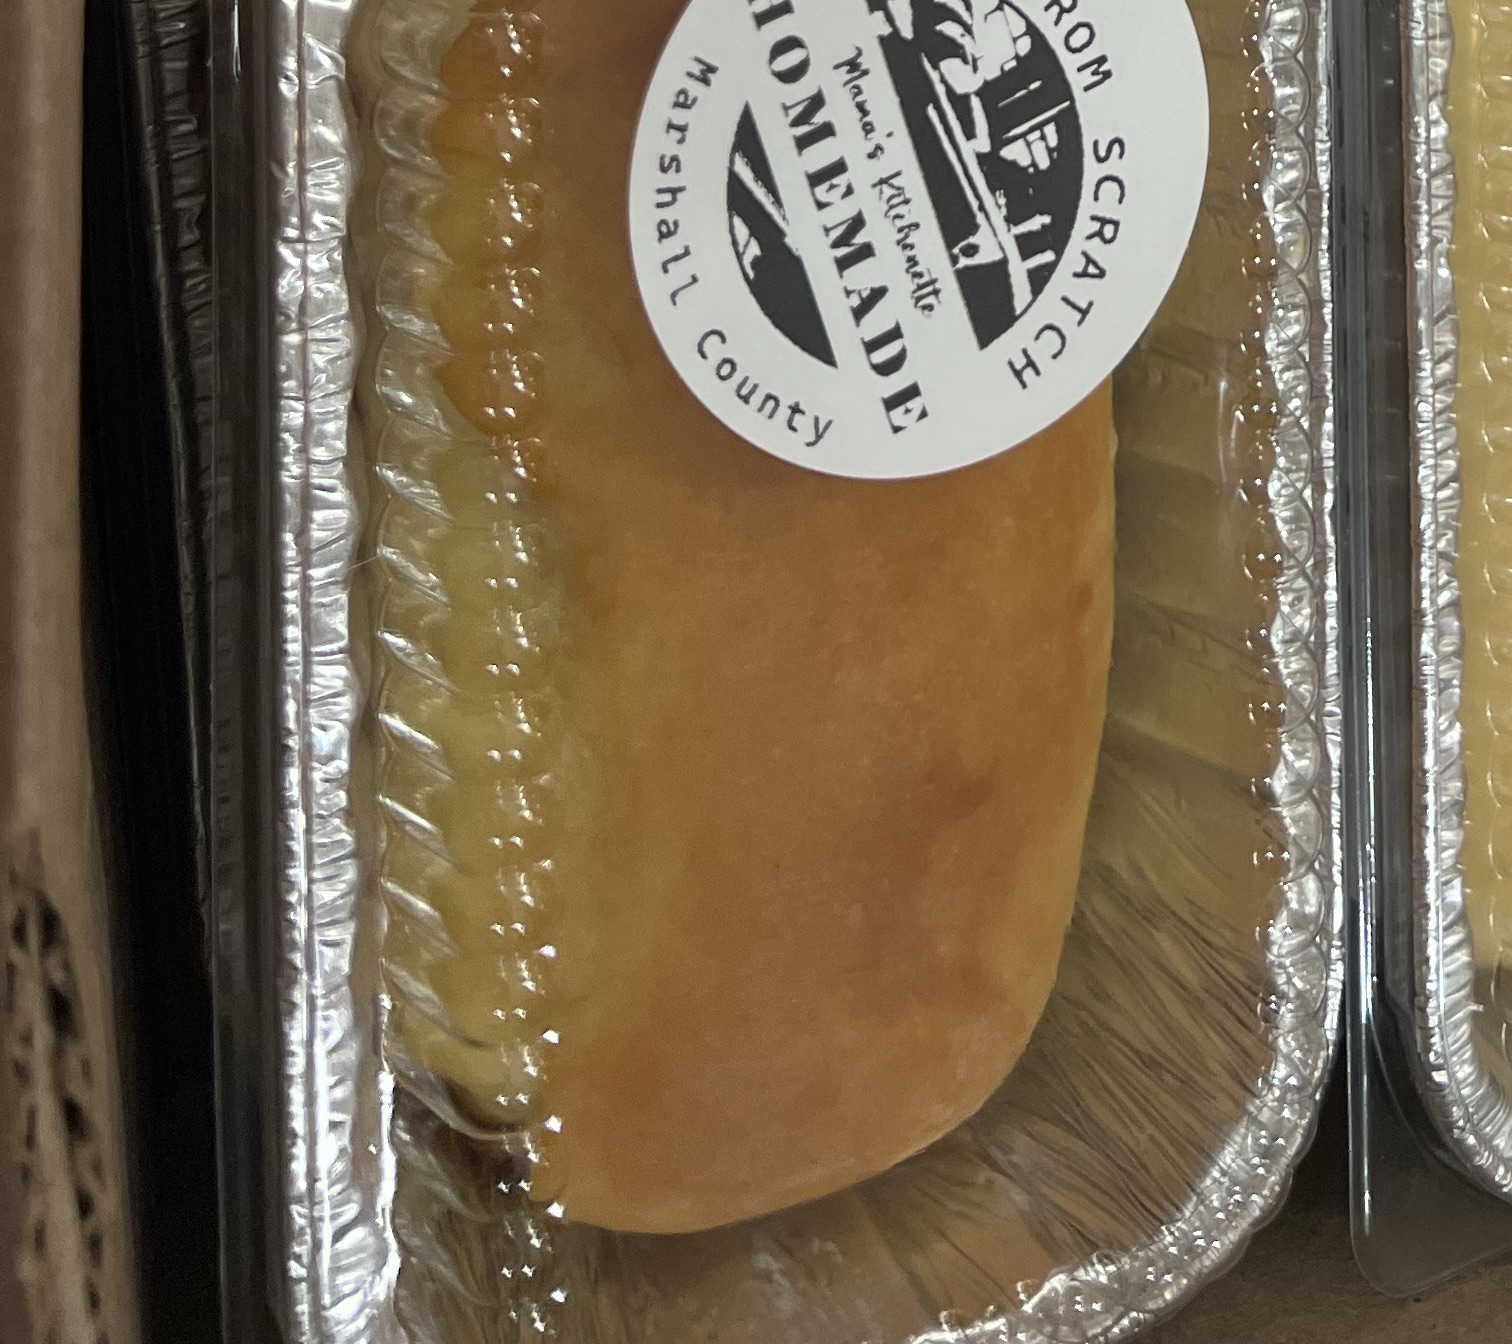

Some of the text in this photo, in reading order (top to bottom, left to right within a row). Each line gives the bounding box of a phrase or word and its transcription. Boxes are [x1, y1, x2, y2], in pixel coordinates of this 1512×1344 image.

[654, 56, 835, 448] Marshall County
[1007, 135, 1126, 390] SCRATCH
